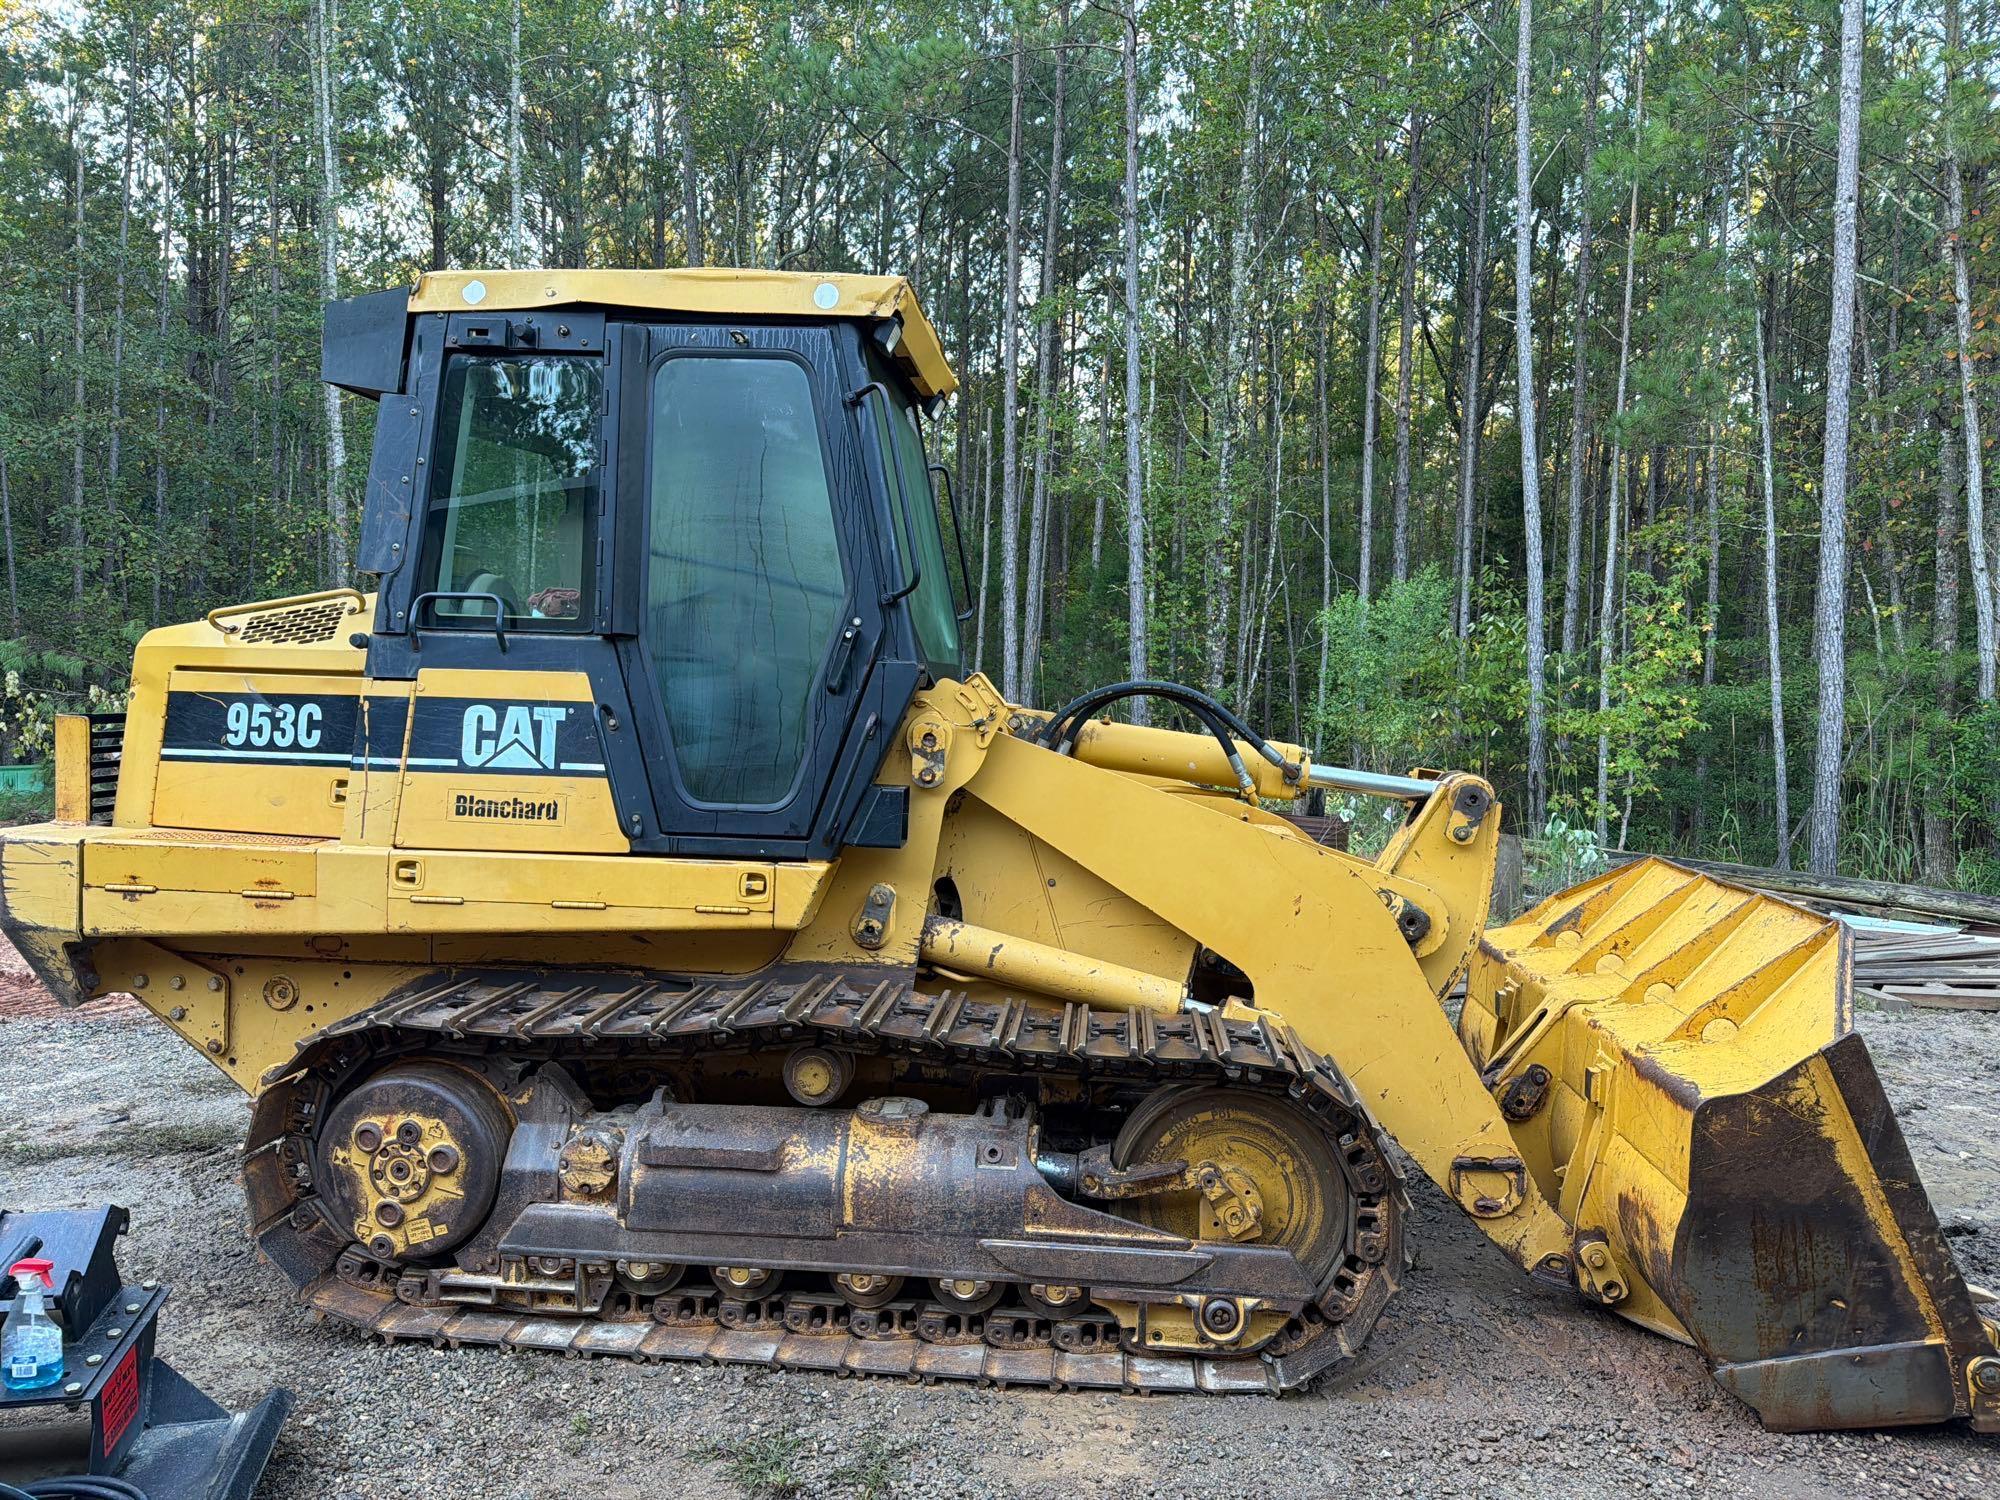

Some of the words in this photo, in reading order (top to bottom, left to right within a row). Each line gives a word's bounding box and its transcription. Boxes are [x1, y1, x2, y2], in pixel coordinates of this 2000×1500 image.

[226, 702, 322, 748] 953C
[462, 704, 566, 769] CAT
[455, 795, 558, 820] Blanchard
